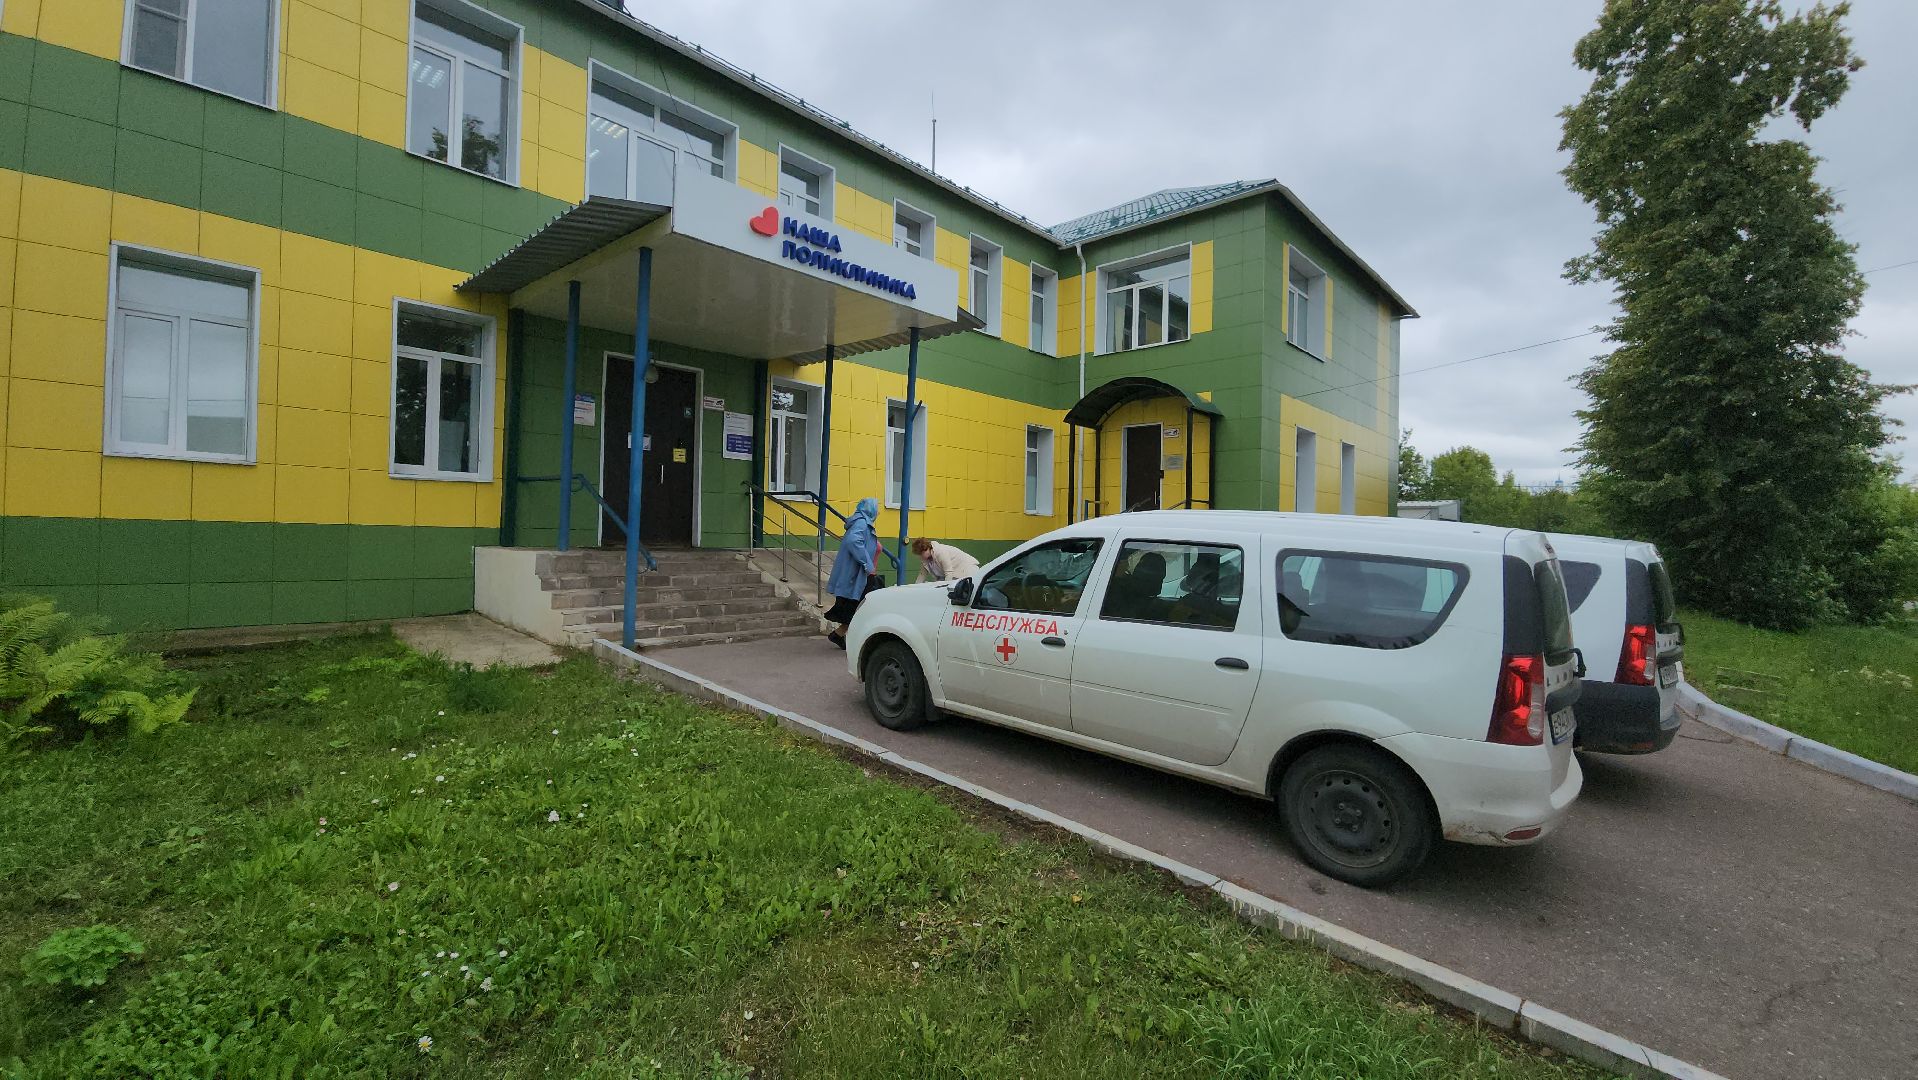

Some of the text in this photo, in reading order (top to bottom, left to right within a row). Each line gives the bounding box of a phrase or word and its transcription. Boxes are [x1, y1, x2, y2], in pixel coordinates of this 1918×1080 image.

[783, 216, 842, 253] НАША
[782, 239, 917, 300] ПОЛИКЛИНИКА
[951, 611, 1059, 636] МЕДСЛУЖБА
